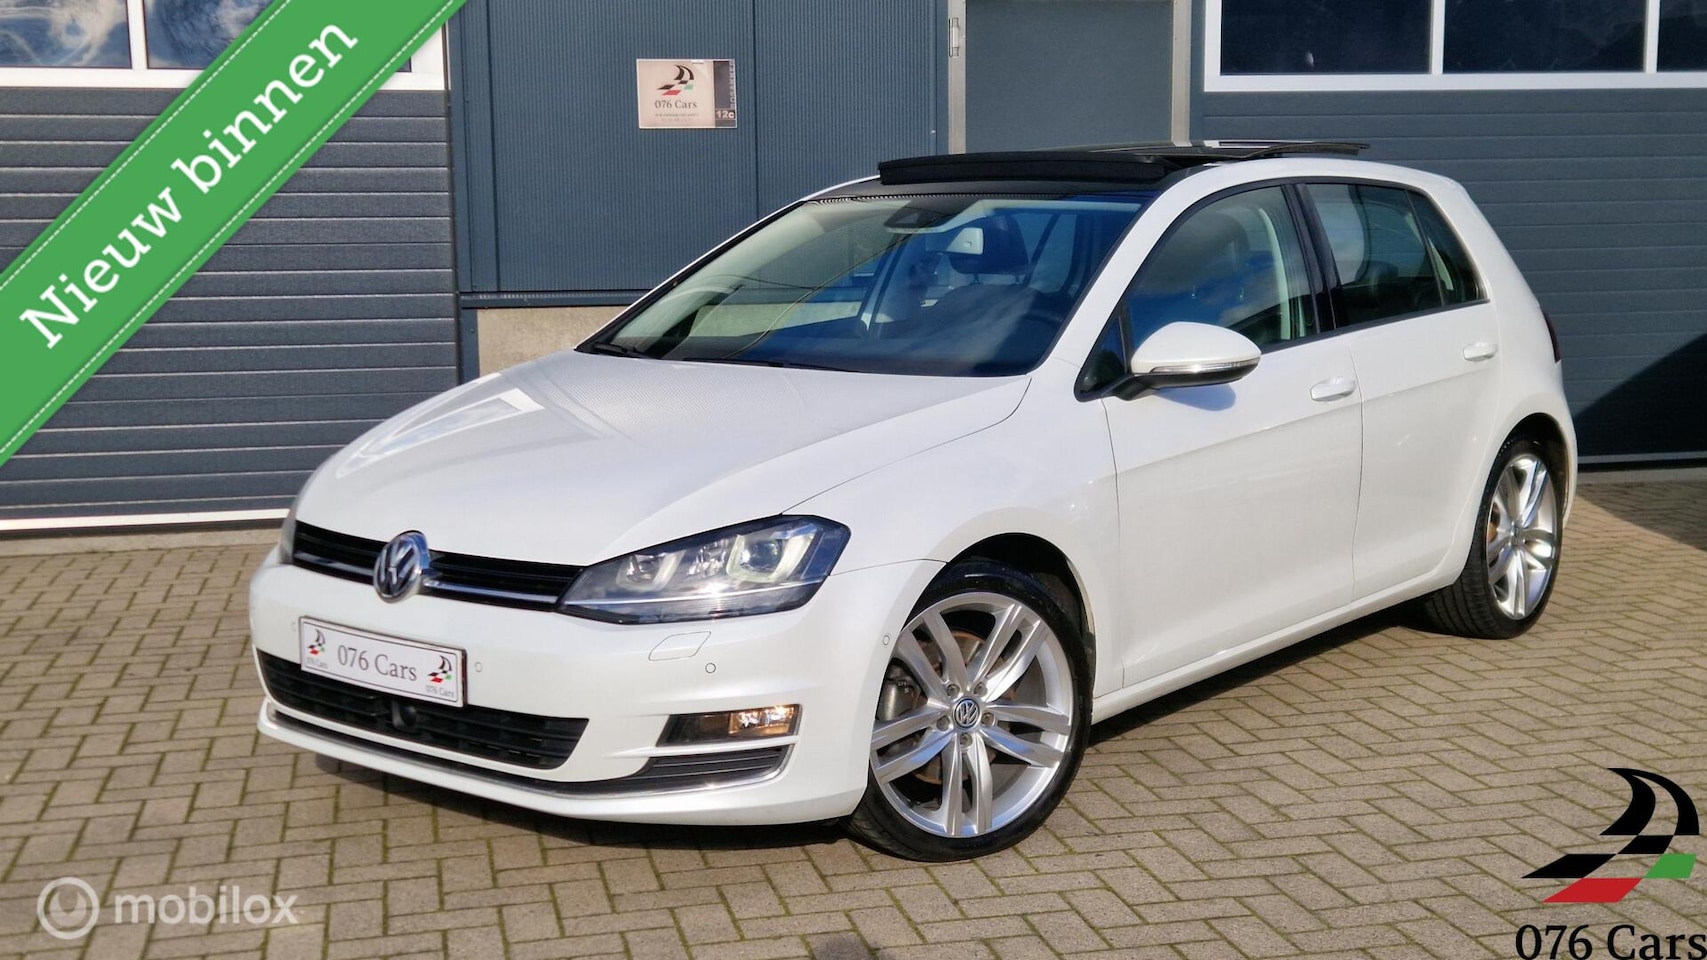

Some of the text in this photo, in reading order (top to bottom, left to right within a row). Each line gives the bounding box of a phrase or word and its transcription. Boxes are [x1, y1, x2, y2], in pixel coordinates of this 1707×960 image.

[654, 100, 698, 109] 076 Cars
[337, 644, 418, 682] 076 Cars
